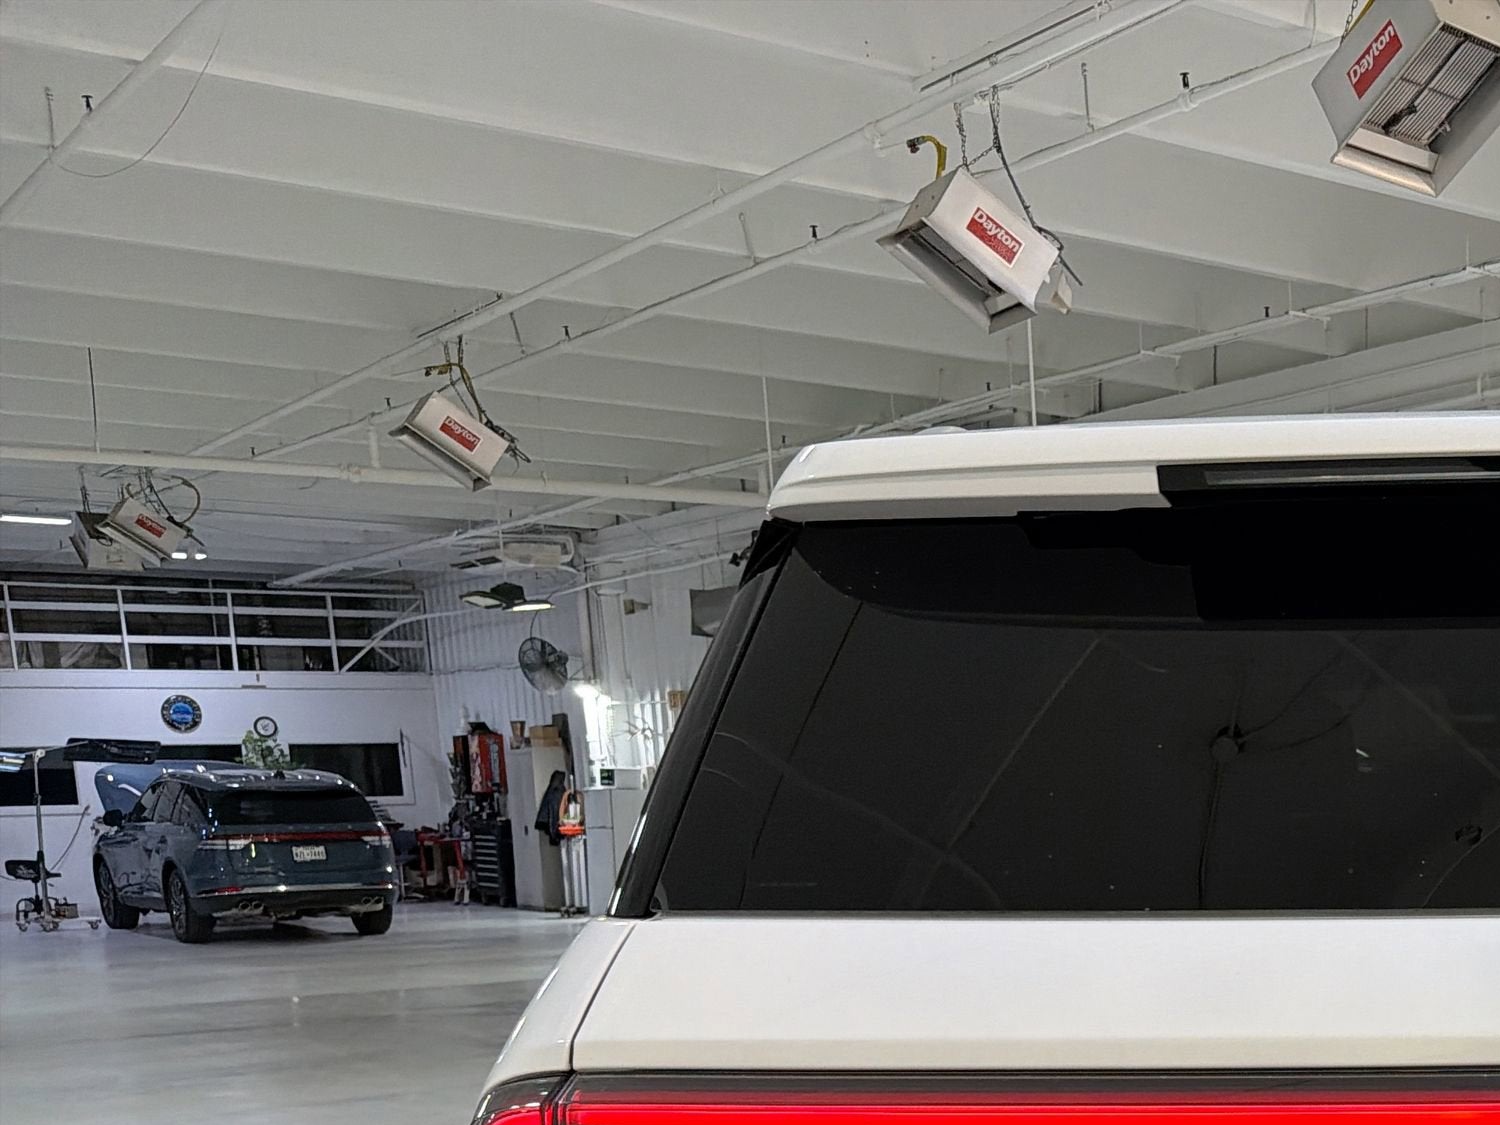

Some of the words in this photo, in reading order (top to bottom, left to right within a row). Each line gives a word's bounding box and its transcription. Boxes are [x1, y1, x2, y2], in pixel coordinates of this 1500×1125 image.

[1349, 24, 1396, 86] Dayton
[973, 209, 1021, 253] Dayton
[444, 418, 480, 446] Dayton
